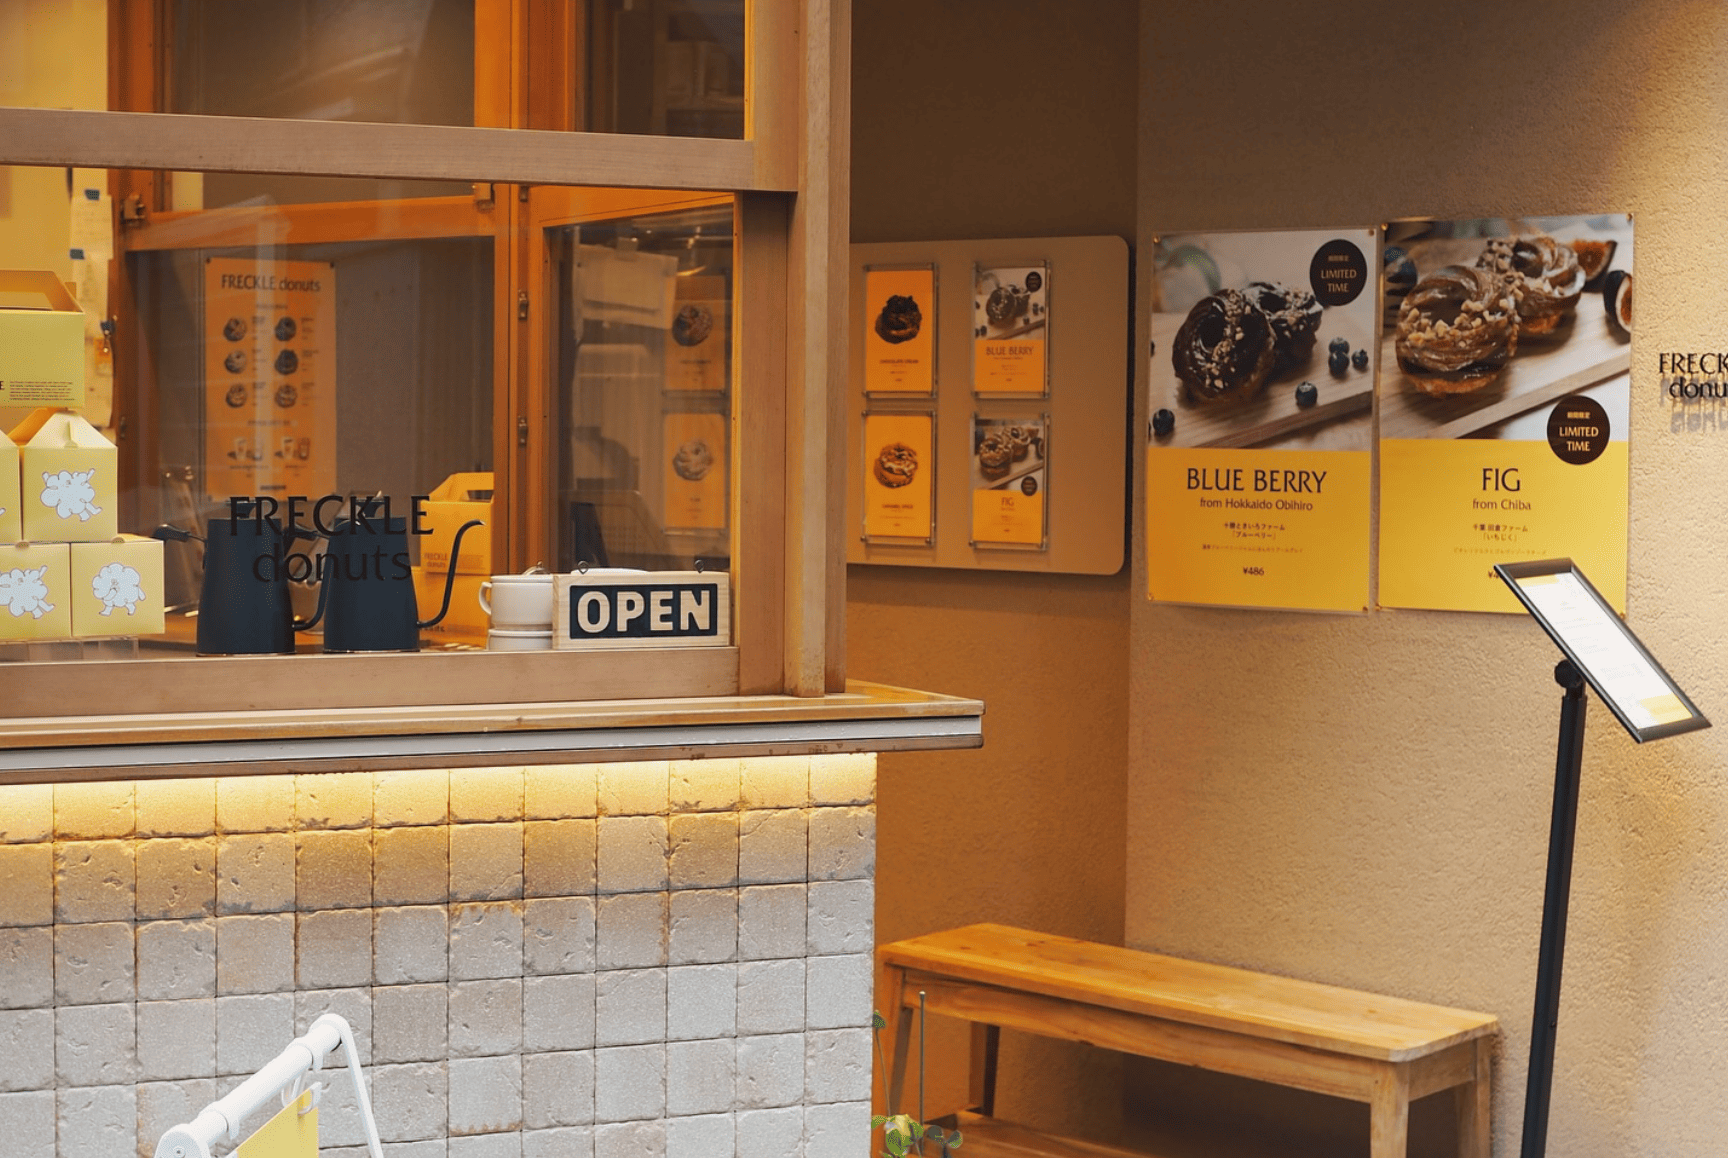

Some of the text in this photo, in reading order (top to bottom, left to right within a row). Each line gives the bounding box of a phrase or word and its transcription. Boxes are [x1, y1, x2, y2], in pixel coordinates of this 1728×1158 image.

[1321, 269, 1357, 279] LIMITED
[221, 274, 321, 292] FRECKLE donuts
[1328, 283, 1349, 293] TIME
[1559, 427, 1599, 437] LIMITED
[1567, 441, 1590, 452] TIME
[1187, 468, 1327, 494] BLUE BERRY
[1482, 468, 1521, 492] FIG
[1200, 497, 1314, 511] from Hokkaido Obihiro
[1472, 498, 1531, 511] from Chiba
[229, 495, 434, 537] FRECKLE
[252, 542, 413, 584] donuts
[1243, 566, 1264, 576] ¥486
[577, 589, 711, 634] OPEN
